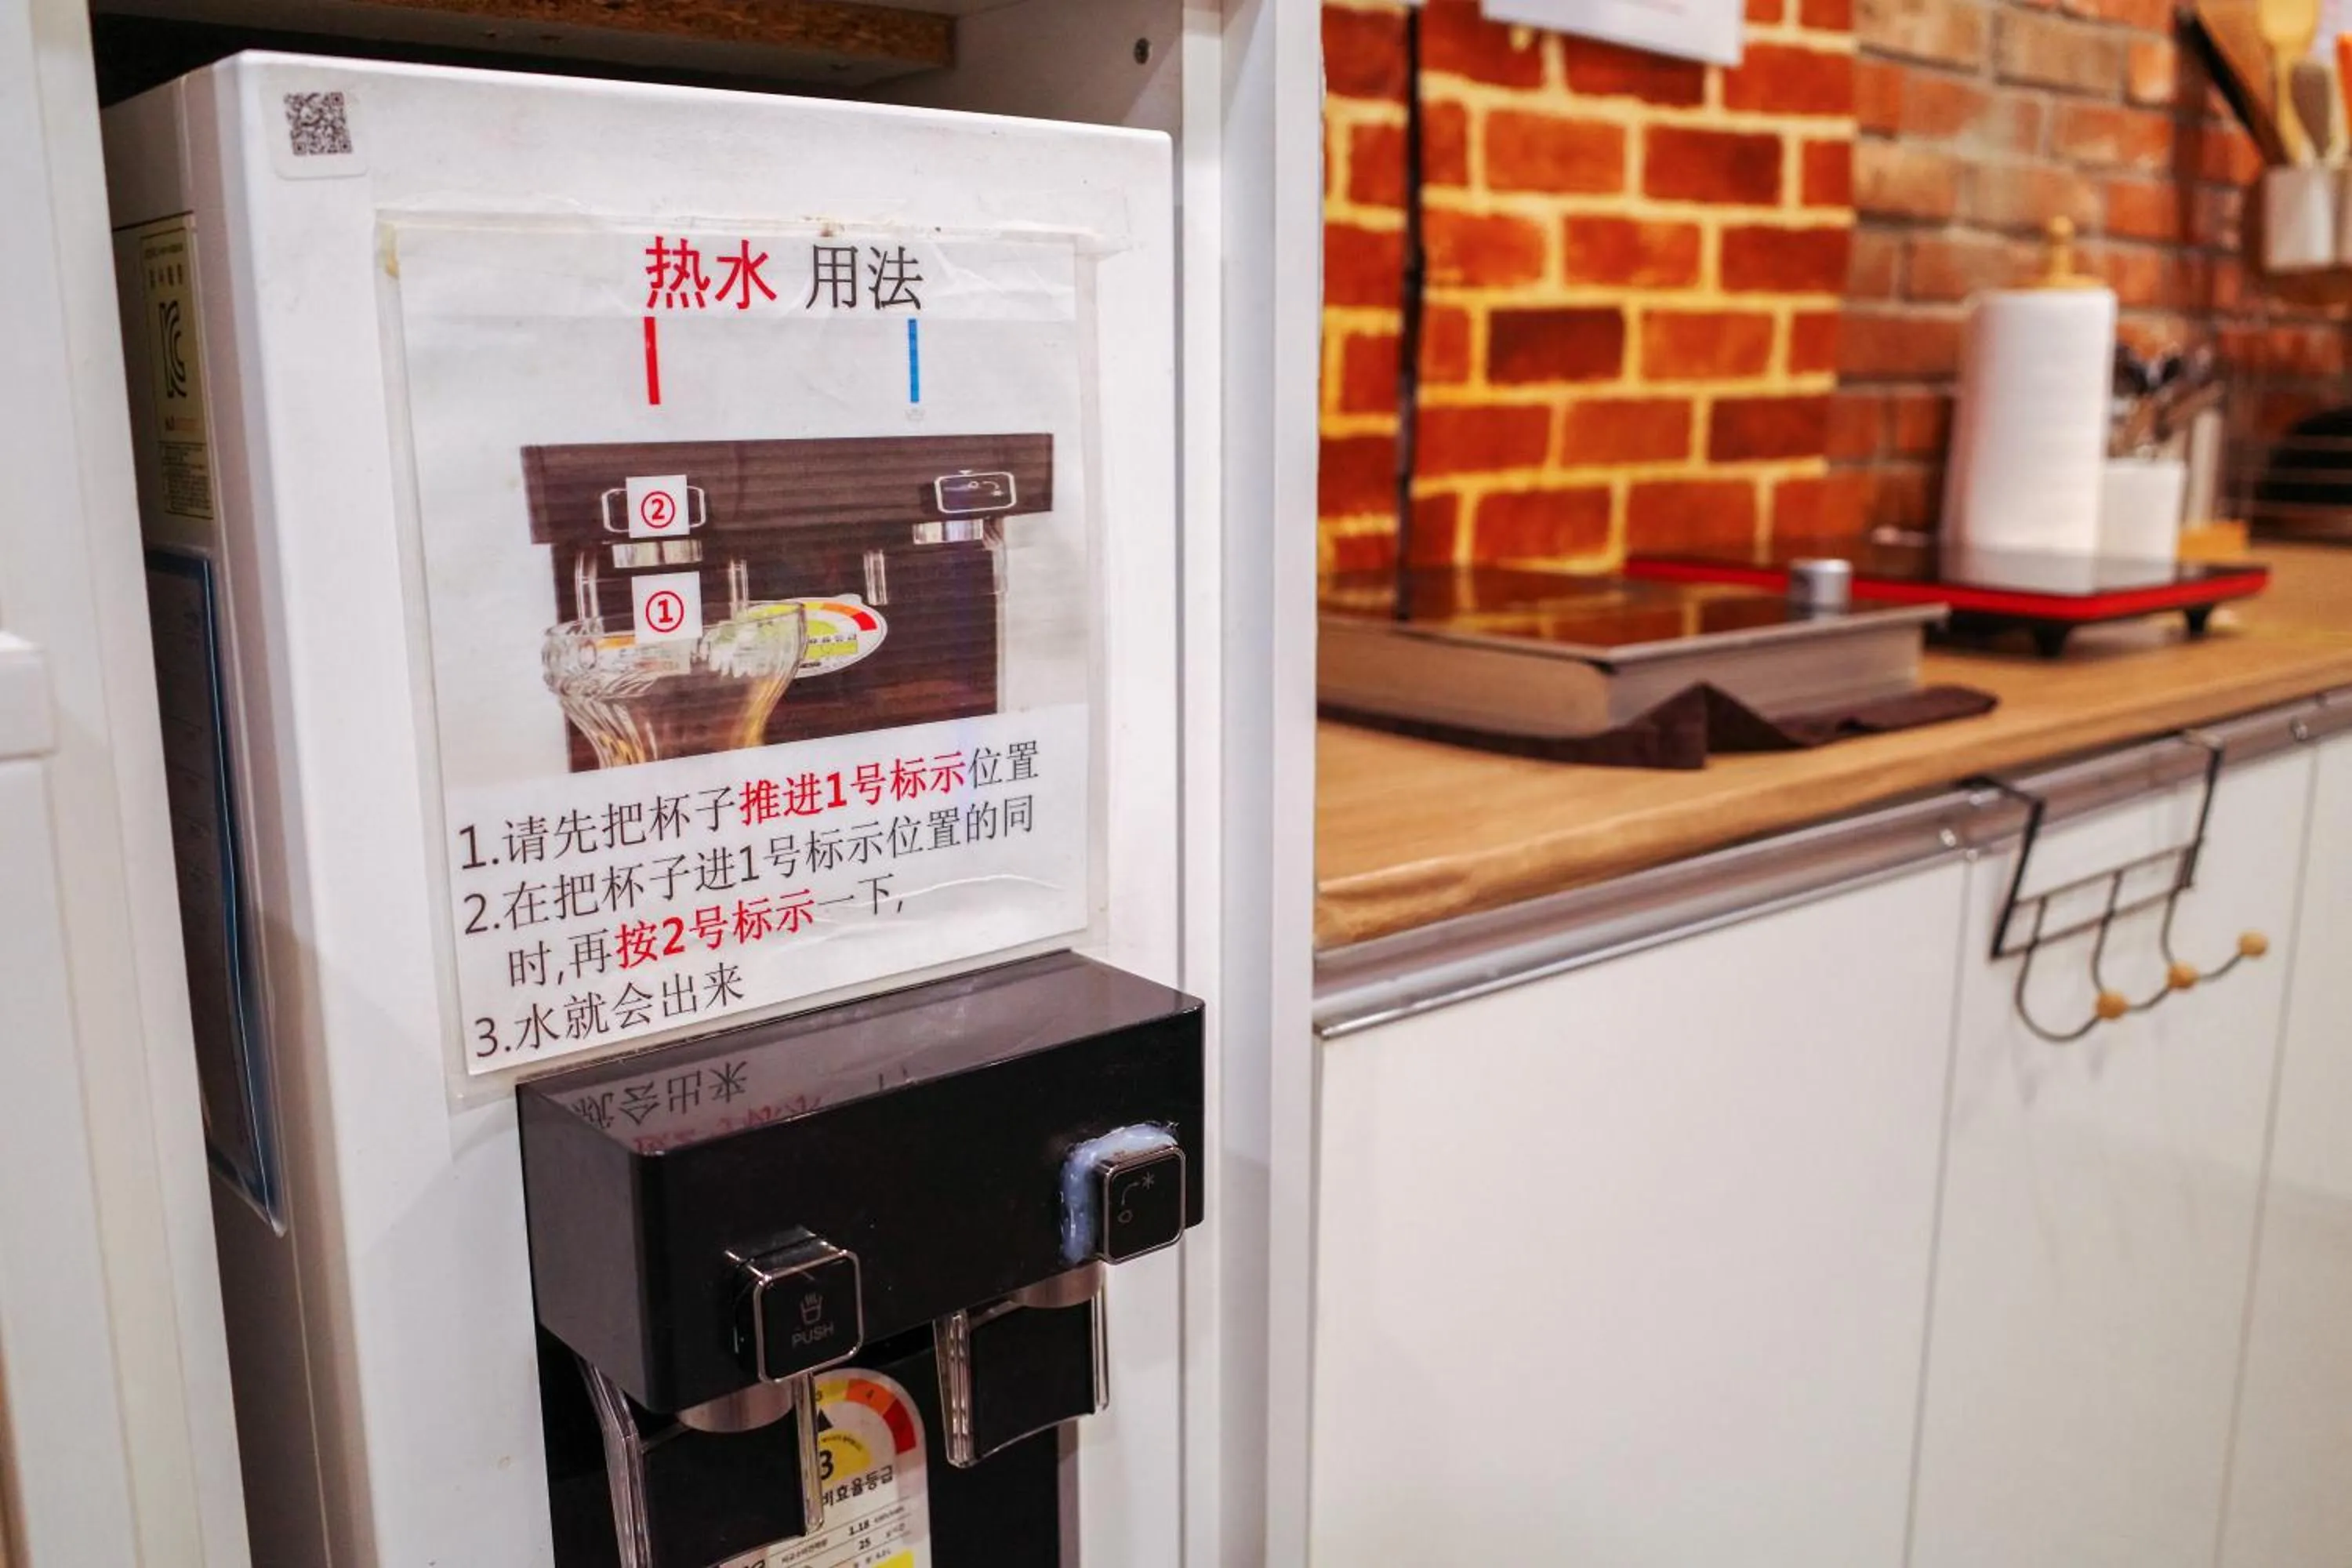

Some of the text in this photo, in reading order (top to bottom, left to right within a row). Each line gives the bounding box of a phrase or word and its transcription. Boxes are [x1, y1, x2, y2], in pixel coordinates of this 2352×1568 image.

[645, 236, 923, 310] 热水 用法
[474, 962, 745, 1058] 3.水就会出来
[792, 1322, 834, 1348] PUSH
